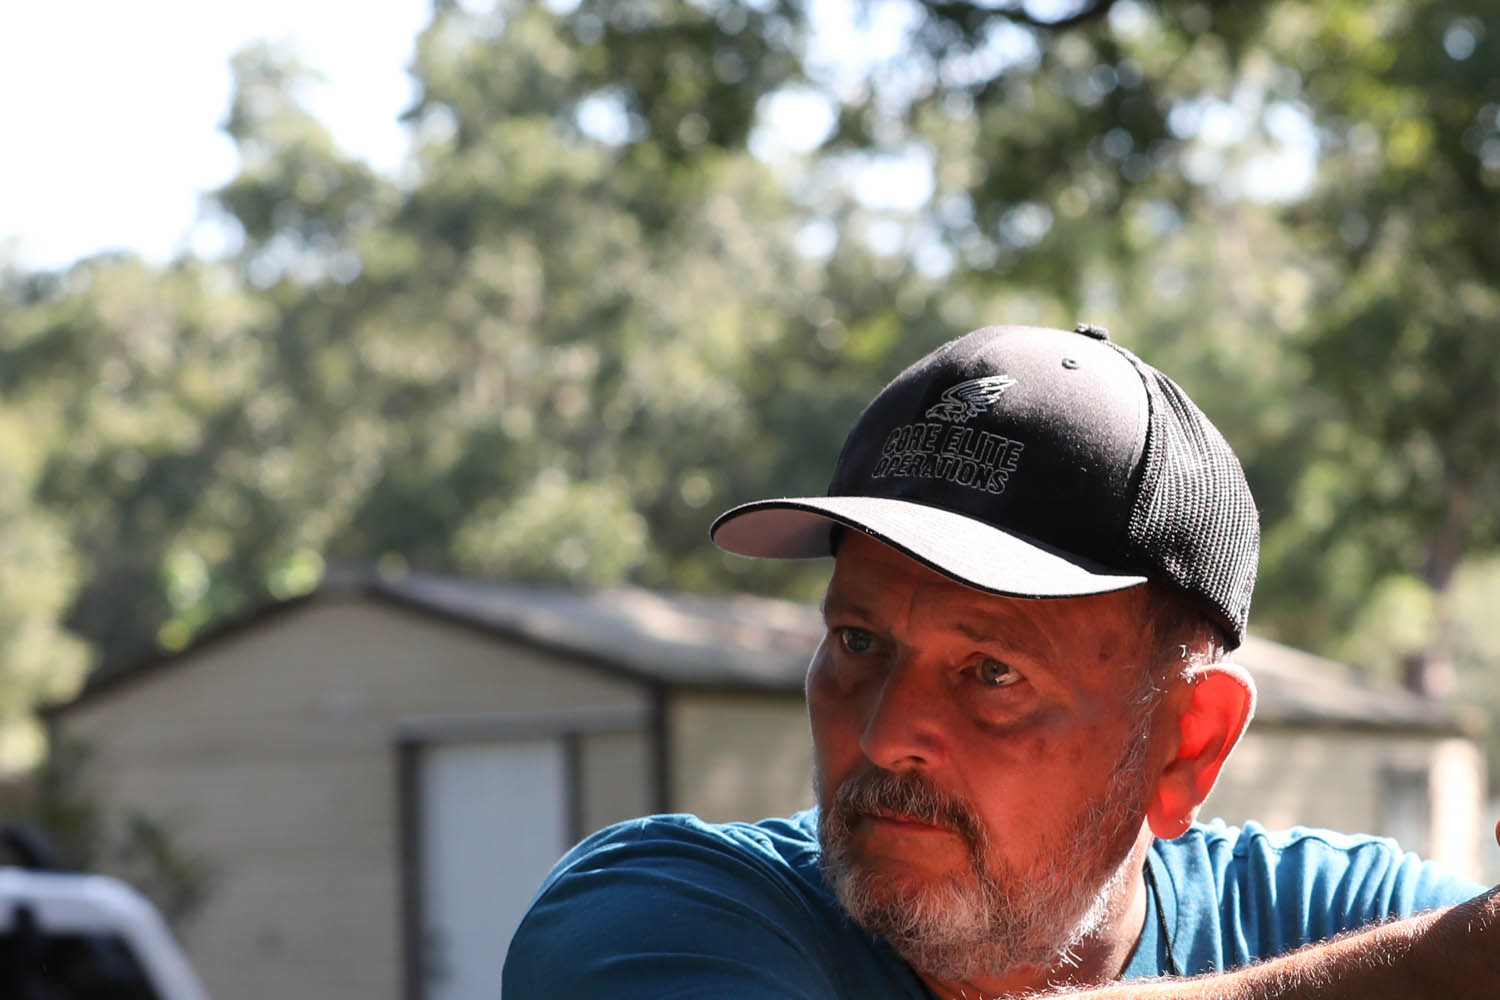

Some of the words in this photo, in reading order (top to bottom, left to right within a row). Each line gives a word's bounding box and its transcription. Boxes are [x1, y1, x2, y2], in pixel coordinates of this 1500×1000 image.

[881, 422, 943, 456] CORE
[942, 425, 1025, 473] ELITE
[871, 453, 1009, 495] OPERATIONS
